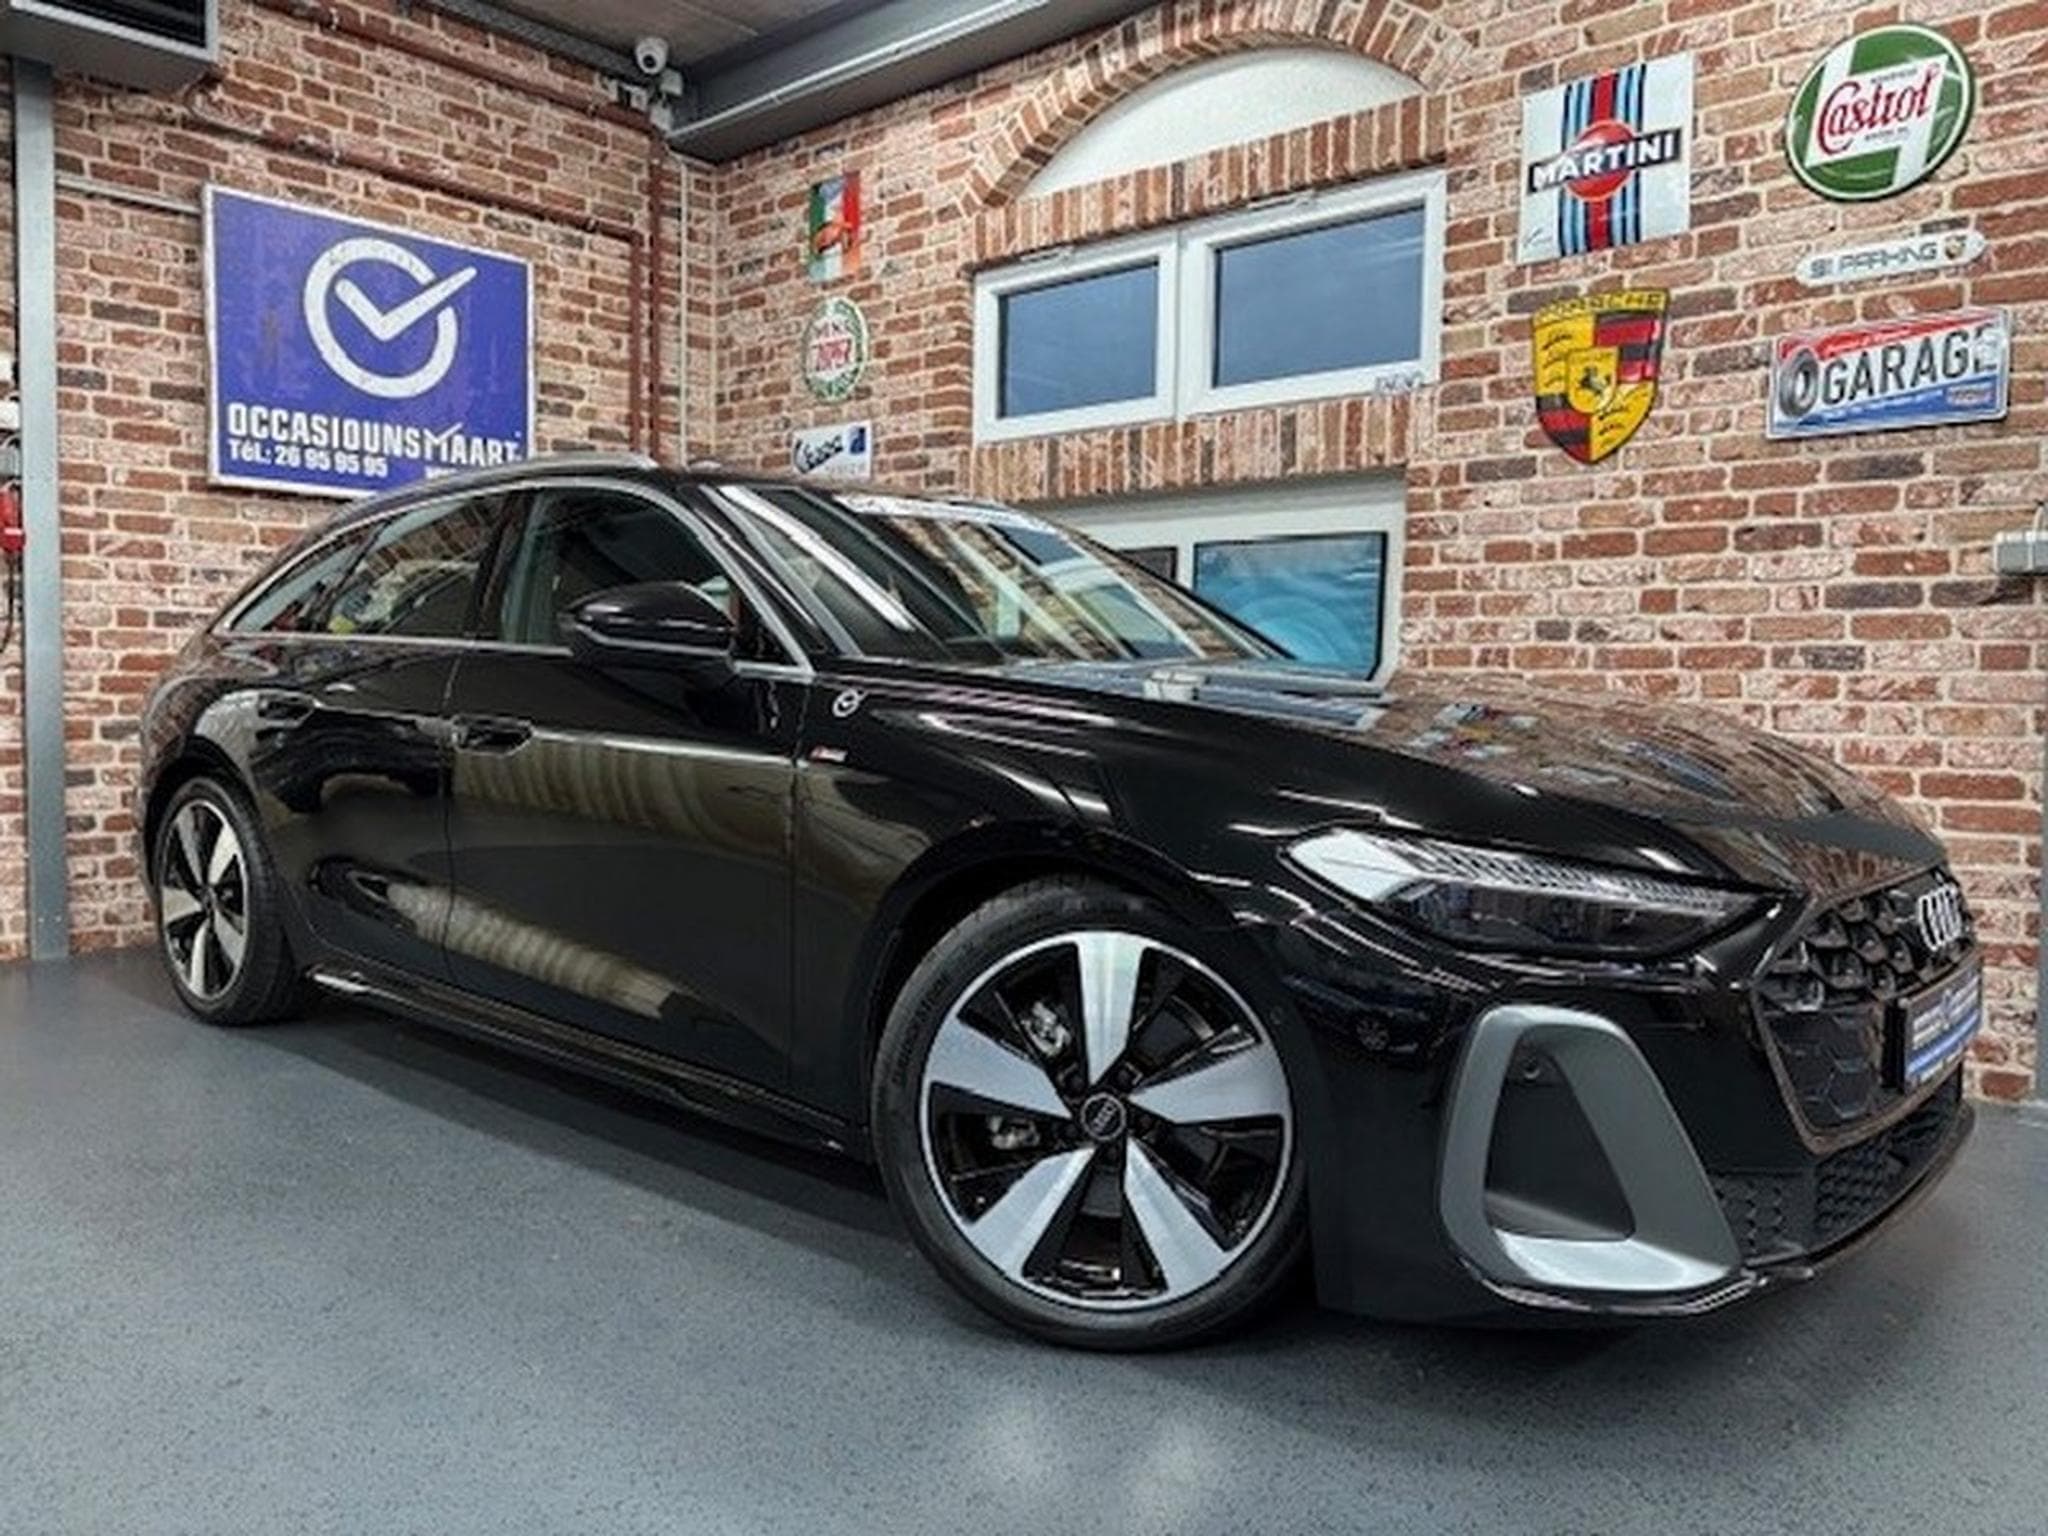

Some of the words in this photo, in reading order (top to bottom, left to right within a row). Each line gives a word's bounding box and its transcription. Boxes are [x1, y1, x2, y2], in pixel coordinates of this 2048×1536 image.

[1818, 62, 1941, 156] Castrol
[1532, 133, 1675, 190] MARTINI
[1822, 322, 1997, 405] GARAGE
[304, 448, 331, 471] 95
[334, 451, 360, 474] 95
